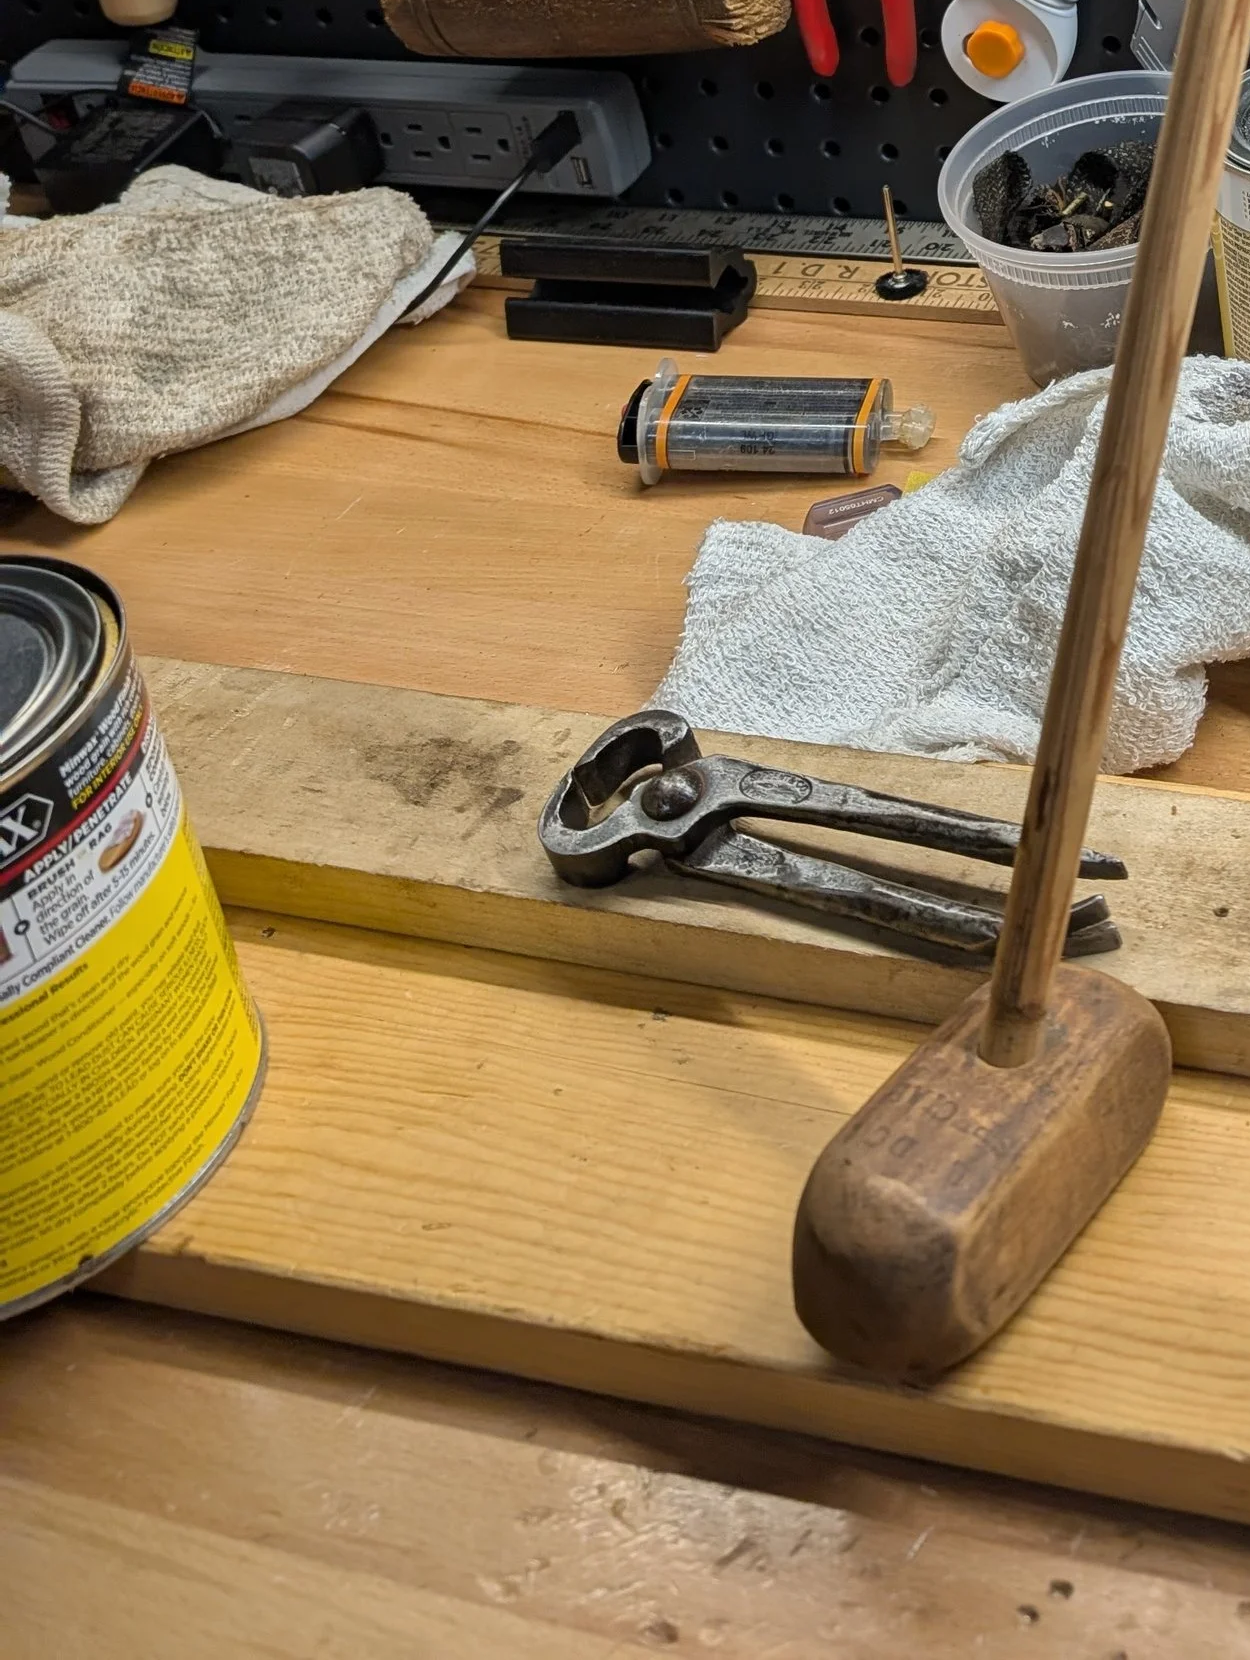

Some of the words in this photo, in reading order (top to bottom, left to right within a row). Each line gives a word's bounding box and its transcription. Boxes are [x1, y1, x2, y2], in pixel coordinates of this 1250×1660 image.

[801, 263, 825, 278] D.
[837, 264, 860, 279] R.
[71, 787, 94, 810] FOR
[93, 745, 127, 789] INTERIOR
[24, 771, 134, 884] APPLY/PENETRATE
[27, 858, 76, 900] BRUSH
[89, 823, 112, 850] RAG
[32, 882, 64, 912] Apply
[65, 874, 76, 886] in
[36, 882, 83, 924] direction
[83, 870, 95, 885] of
[39, 918, 59, 935] the
[61, 895, 90, 923] grain.
[43, 919, 74, 945] Wipe
[75, 906, 91, 923] off
[91, 884, 112, 909] after
[22, 944, 75, 986] Compliant
